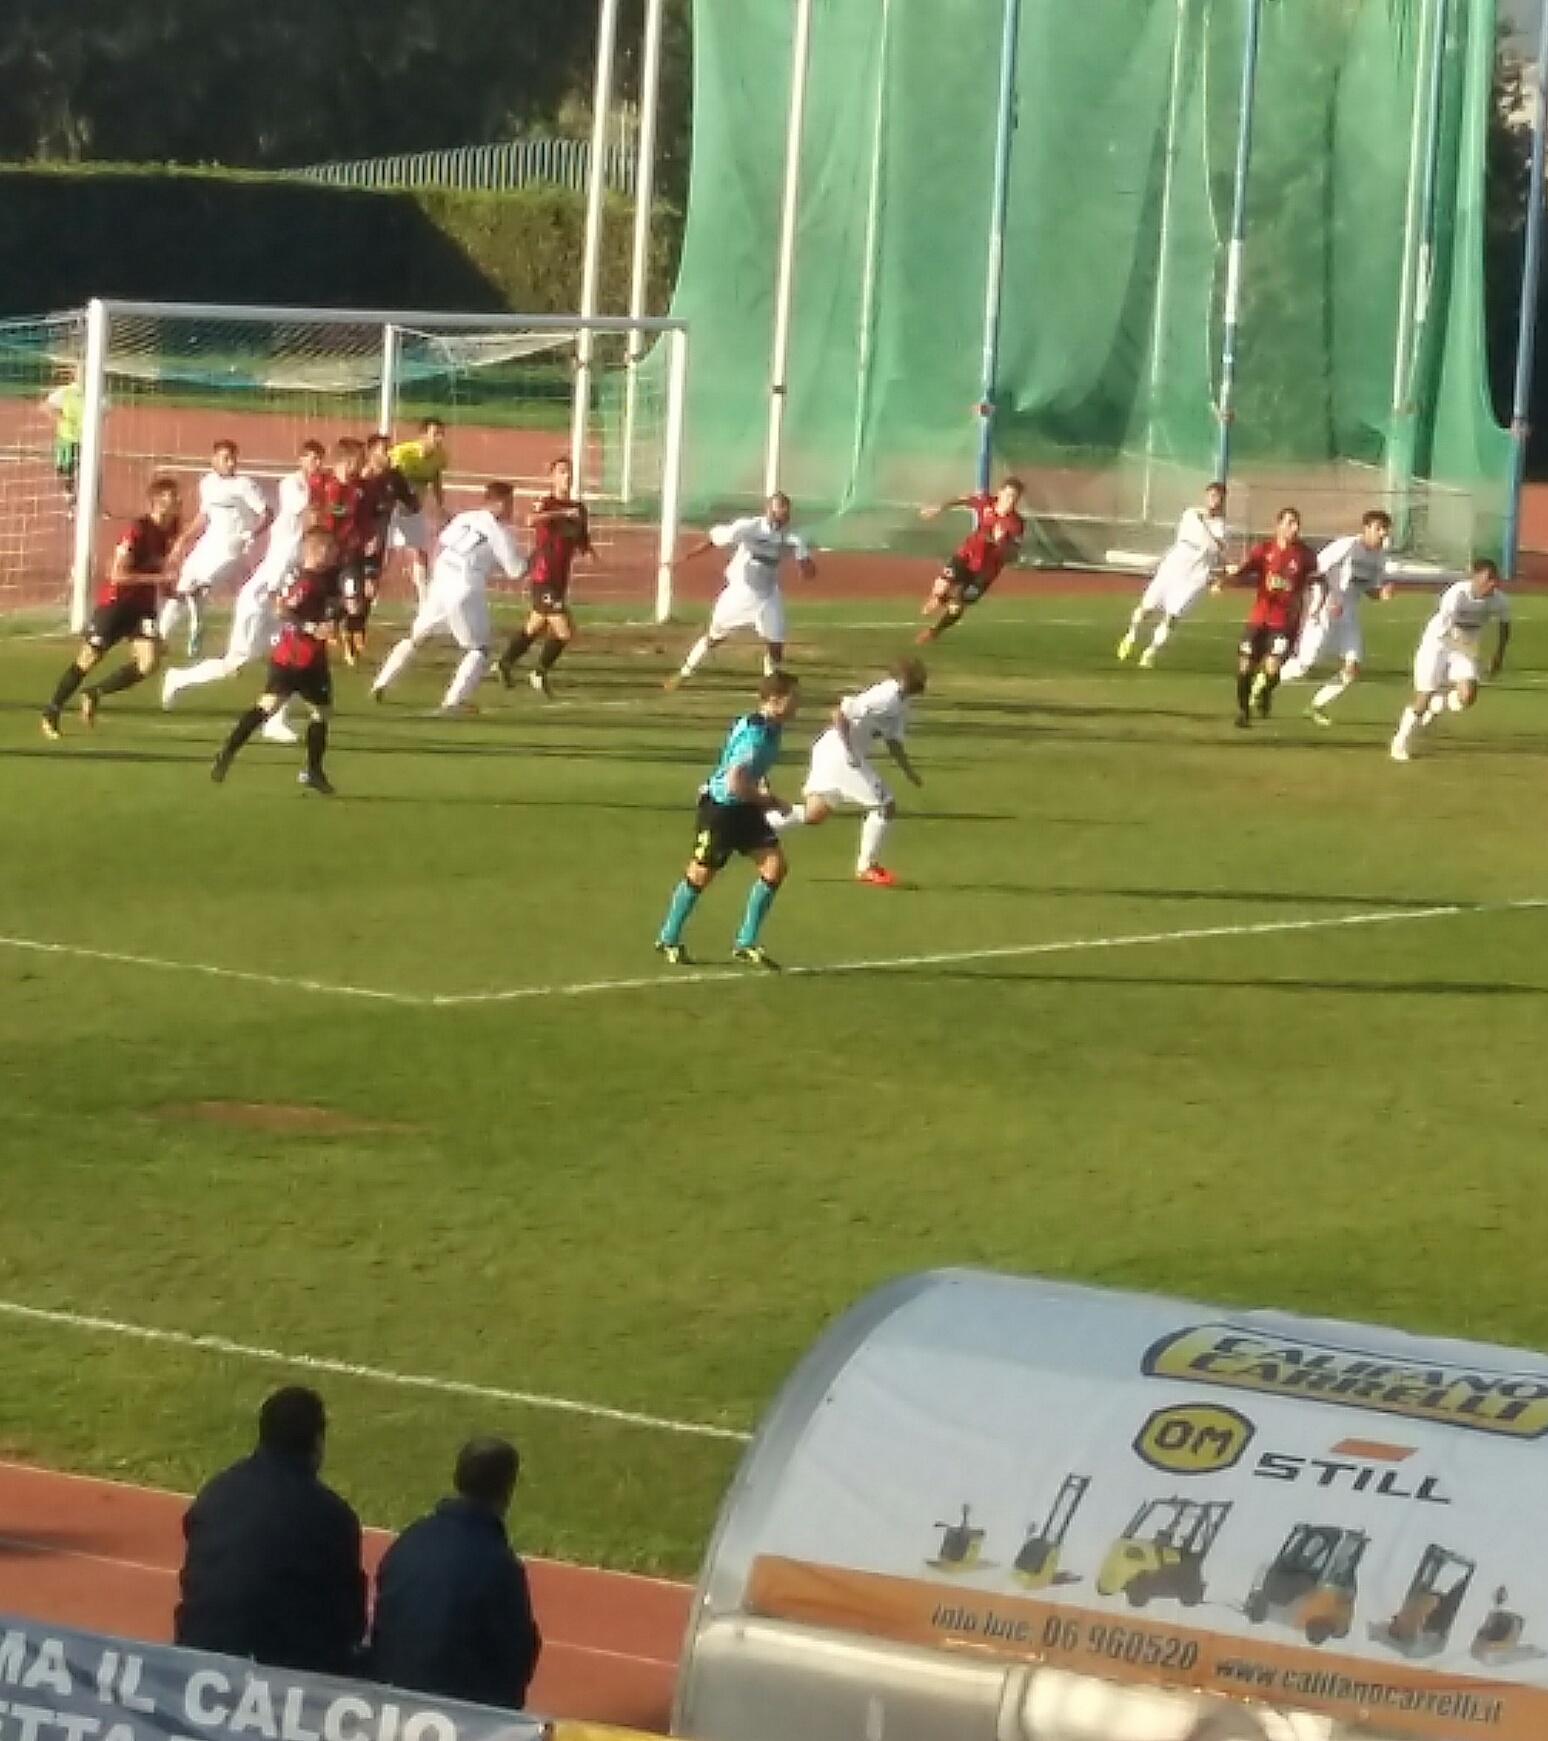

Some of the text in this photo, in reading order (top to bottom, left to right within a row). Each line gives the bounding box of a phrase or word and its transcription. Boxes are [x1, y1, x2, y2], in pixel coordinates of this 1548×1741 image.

[1187, 1351, 1531, 1421] CARRELLI
[1154, 1419, 1234, 1458] OM
[1253, 1451, 1451, 1505] STILL
[1043, 1614, 1079, 1650] 06
[97, 1649, 155, 1714] IL
[184, 1669, 458, 1741] CALCIO
